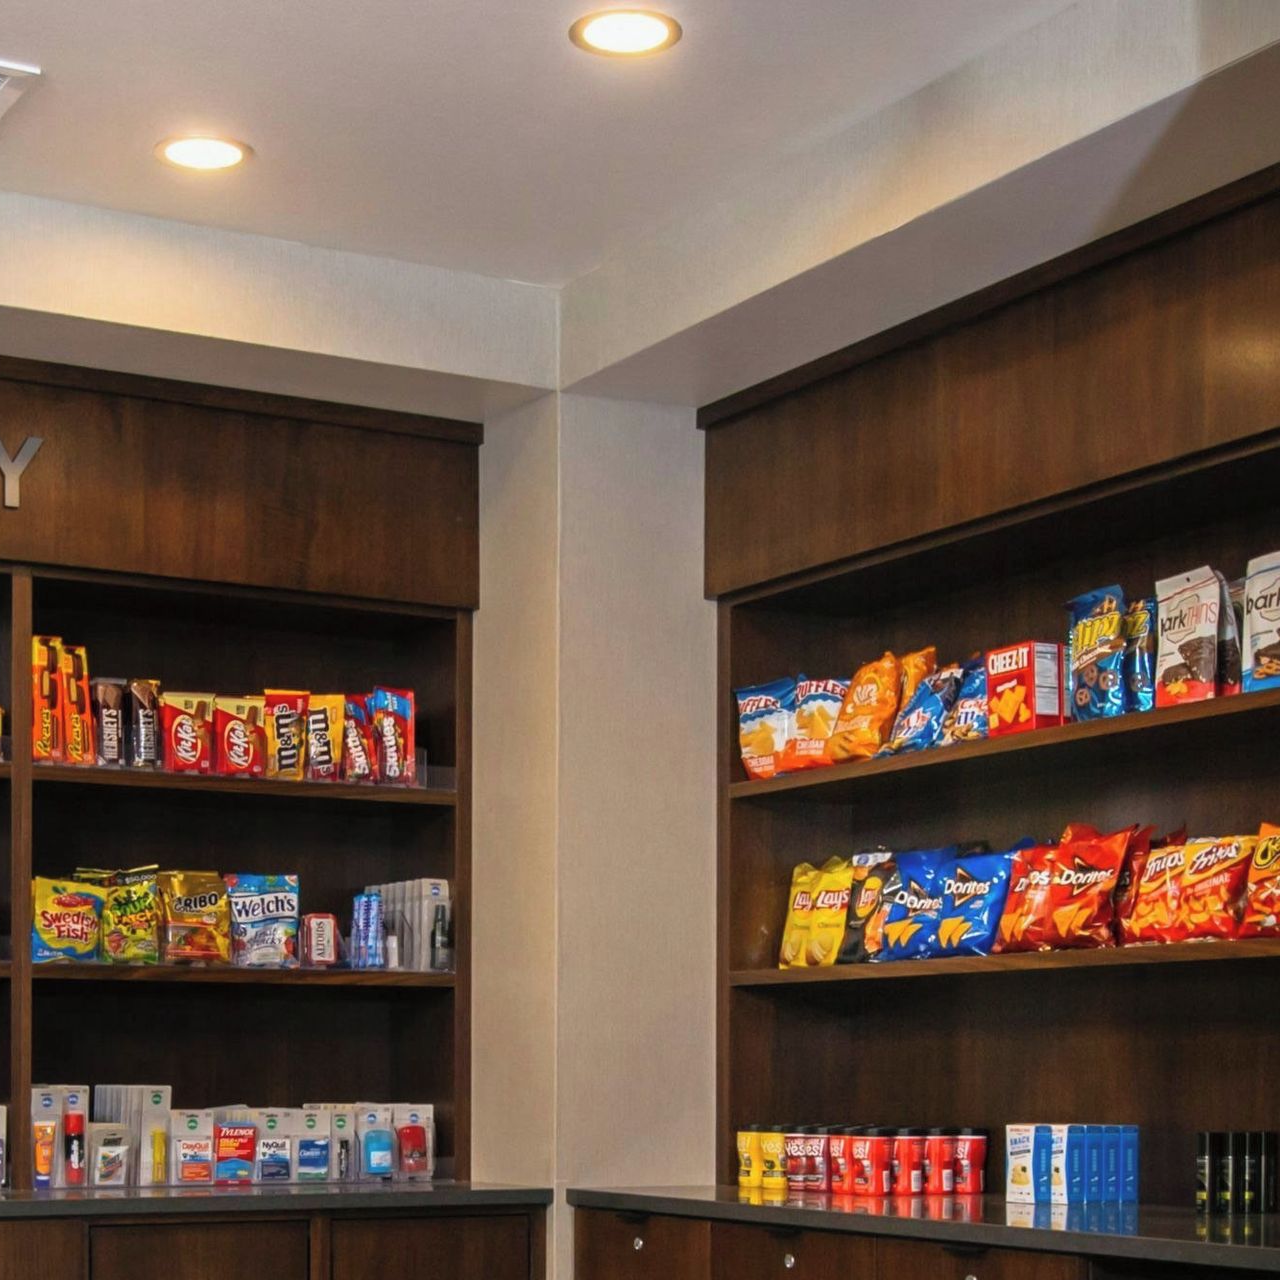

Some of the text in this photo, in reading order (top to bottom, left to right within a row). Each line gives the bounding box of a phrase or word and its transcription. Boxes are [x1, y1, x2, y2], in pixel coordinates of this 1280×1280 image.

[1187, 841, 1239, 875] Fritos
[1058, 867, 1114, 886] Doritos
[944, 878, 991, 896] Doritos
[176, 891, 219, 909] RIBO
[234, 895, 296, 918] Welch's
[816, 889, 850, 912] Lay's
[40, 909, 99, 932] Swedish
[54, 924, 89, 943] Fish
[317, 920, 325, 958] ALTOIDS
[220, 1127, 254, 1137] TYLENOL
[182, 1142, 210, 1152] DayQuil
[262, 1140, 286, 1150] NyQuil
